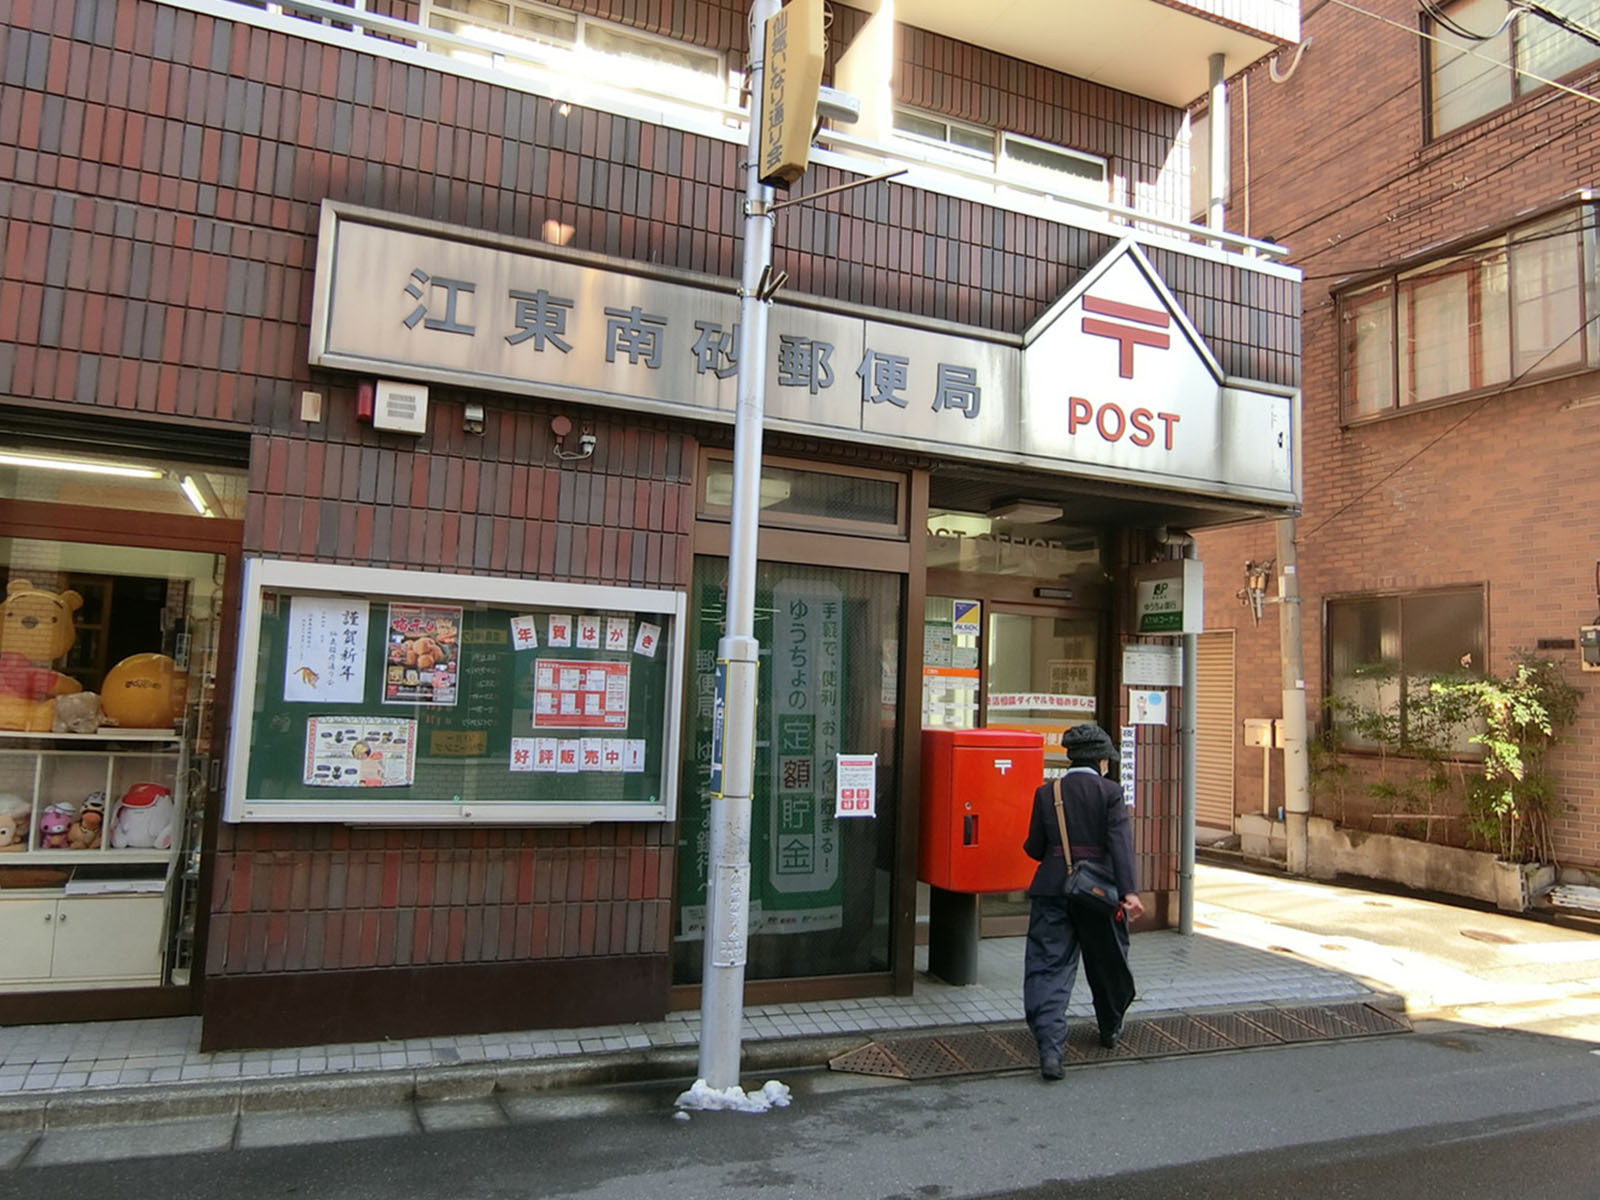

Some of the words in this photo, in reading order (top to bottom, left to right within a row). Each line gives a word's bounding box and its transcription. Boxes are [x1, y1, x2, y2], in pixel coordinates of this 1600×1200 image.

[402, 265, 982, 420] 江東南砂郵便局
[1067, 396, 1181, 451] POST
[339, 610, 359, 681] 謹賀新年
[517, 624, 654, 649] 年賀はがき
[513, 749, 638, 766] 好評販売中!
[779, 602, 814, 872] ゆうちょの定額貯金
